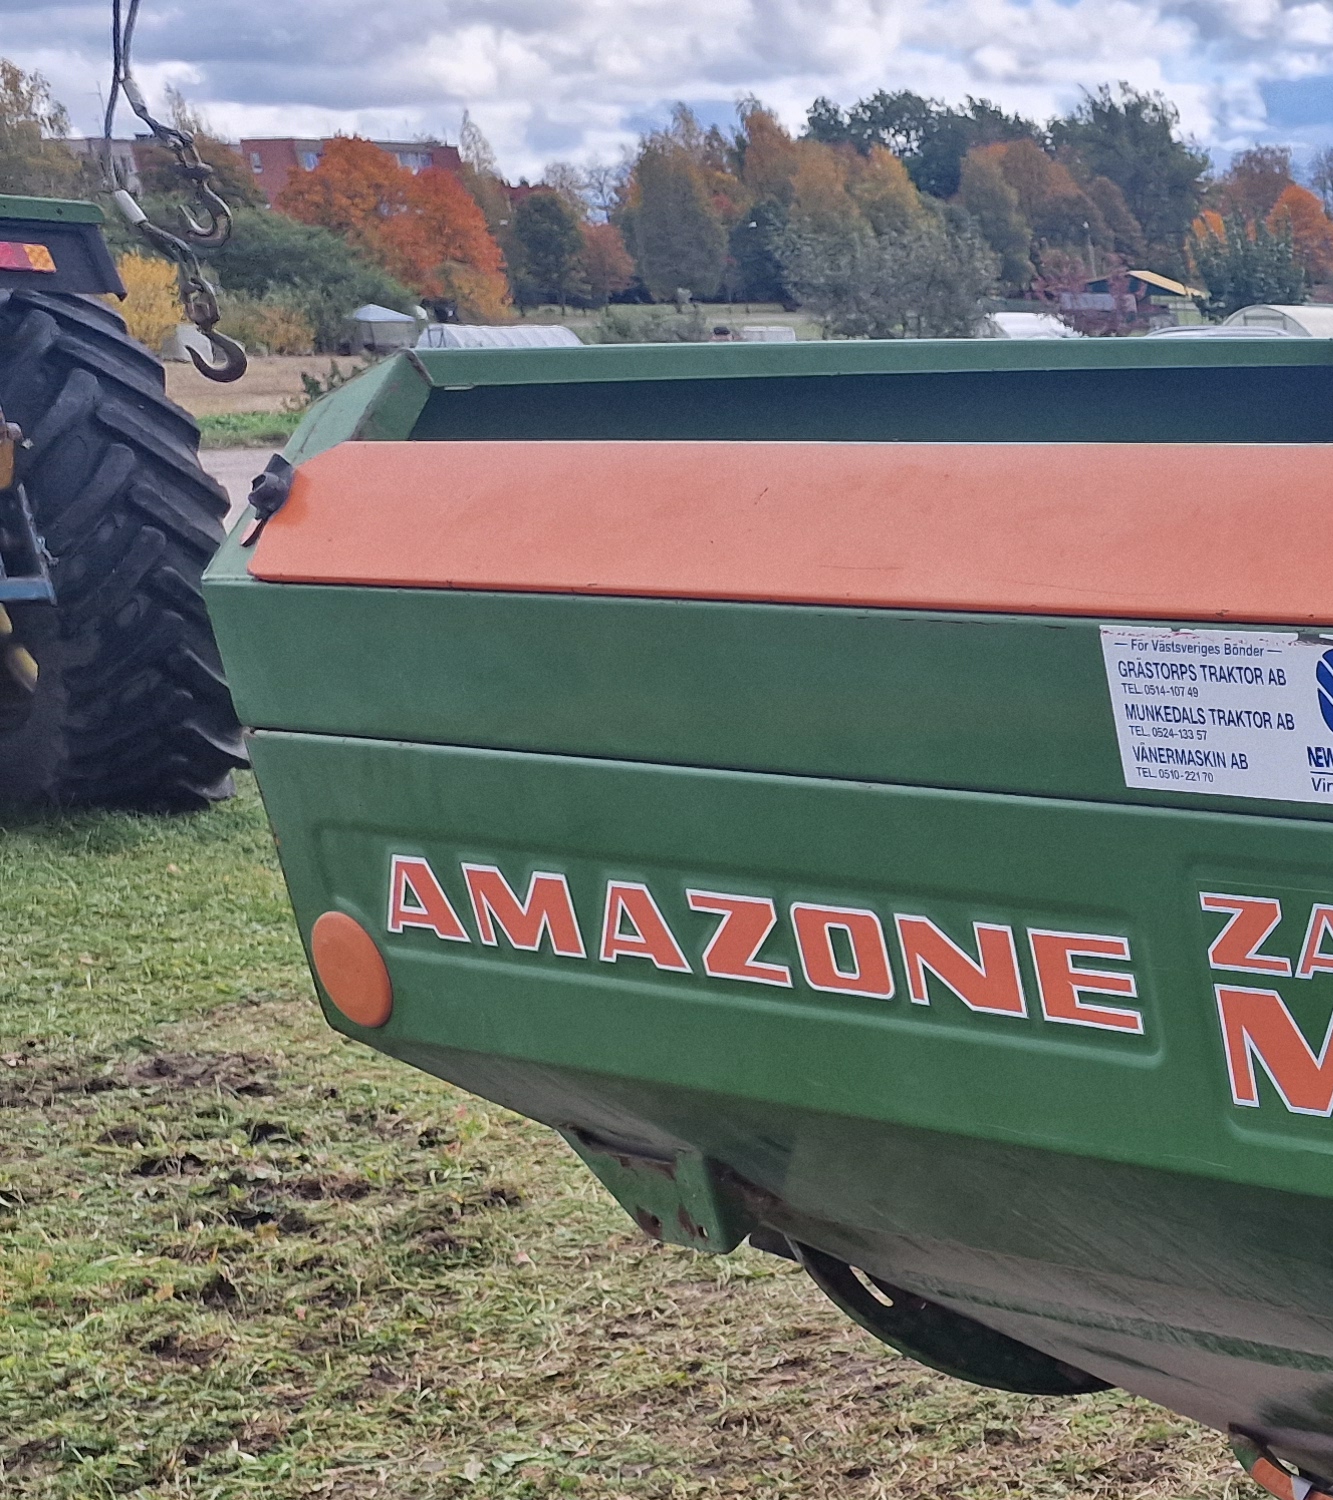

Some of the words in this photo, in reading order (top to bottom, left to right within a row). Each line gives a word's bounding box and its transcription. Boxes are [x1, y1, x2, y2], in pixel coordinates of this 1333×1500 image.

[1152, 639, 1220, 657] Västsveriges
[1200, 664, 1264, 685] TRAKTOR
[1268, 668, 1287, 686] AB
[1124, 703, 1206, 725] MUNKEDALS
[1208, 708, 1273, 729] TRAKTOR
[1277, 712, 1295, 730] AB
[1231, 753, 1249, 770] AB
[387, 852, 1145, 1035] AMAZONE
